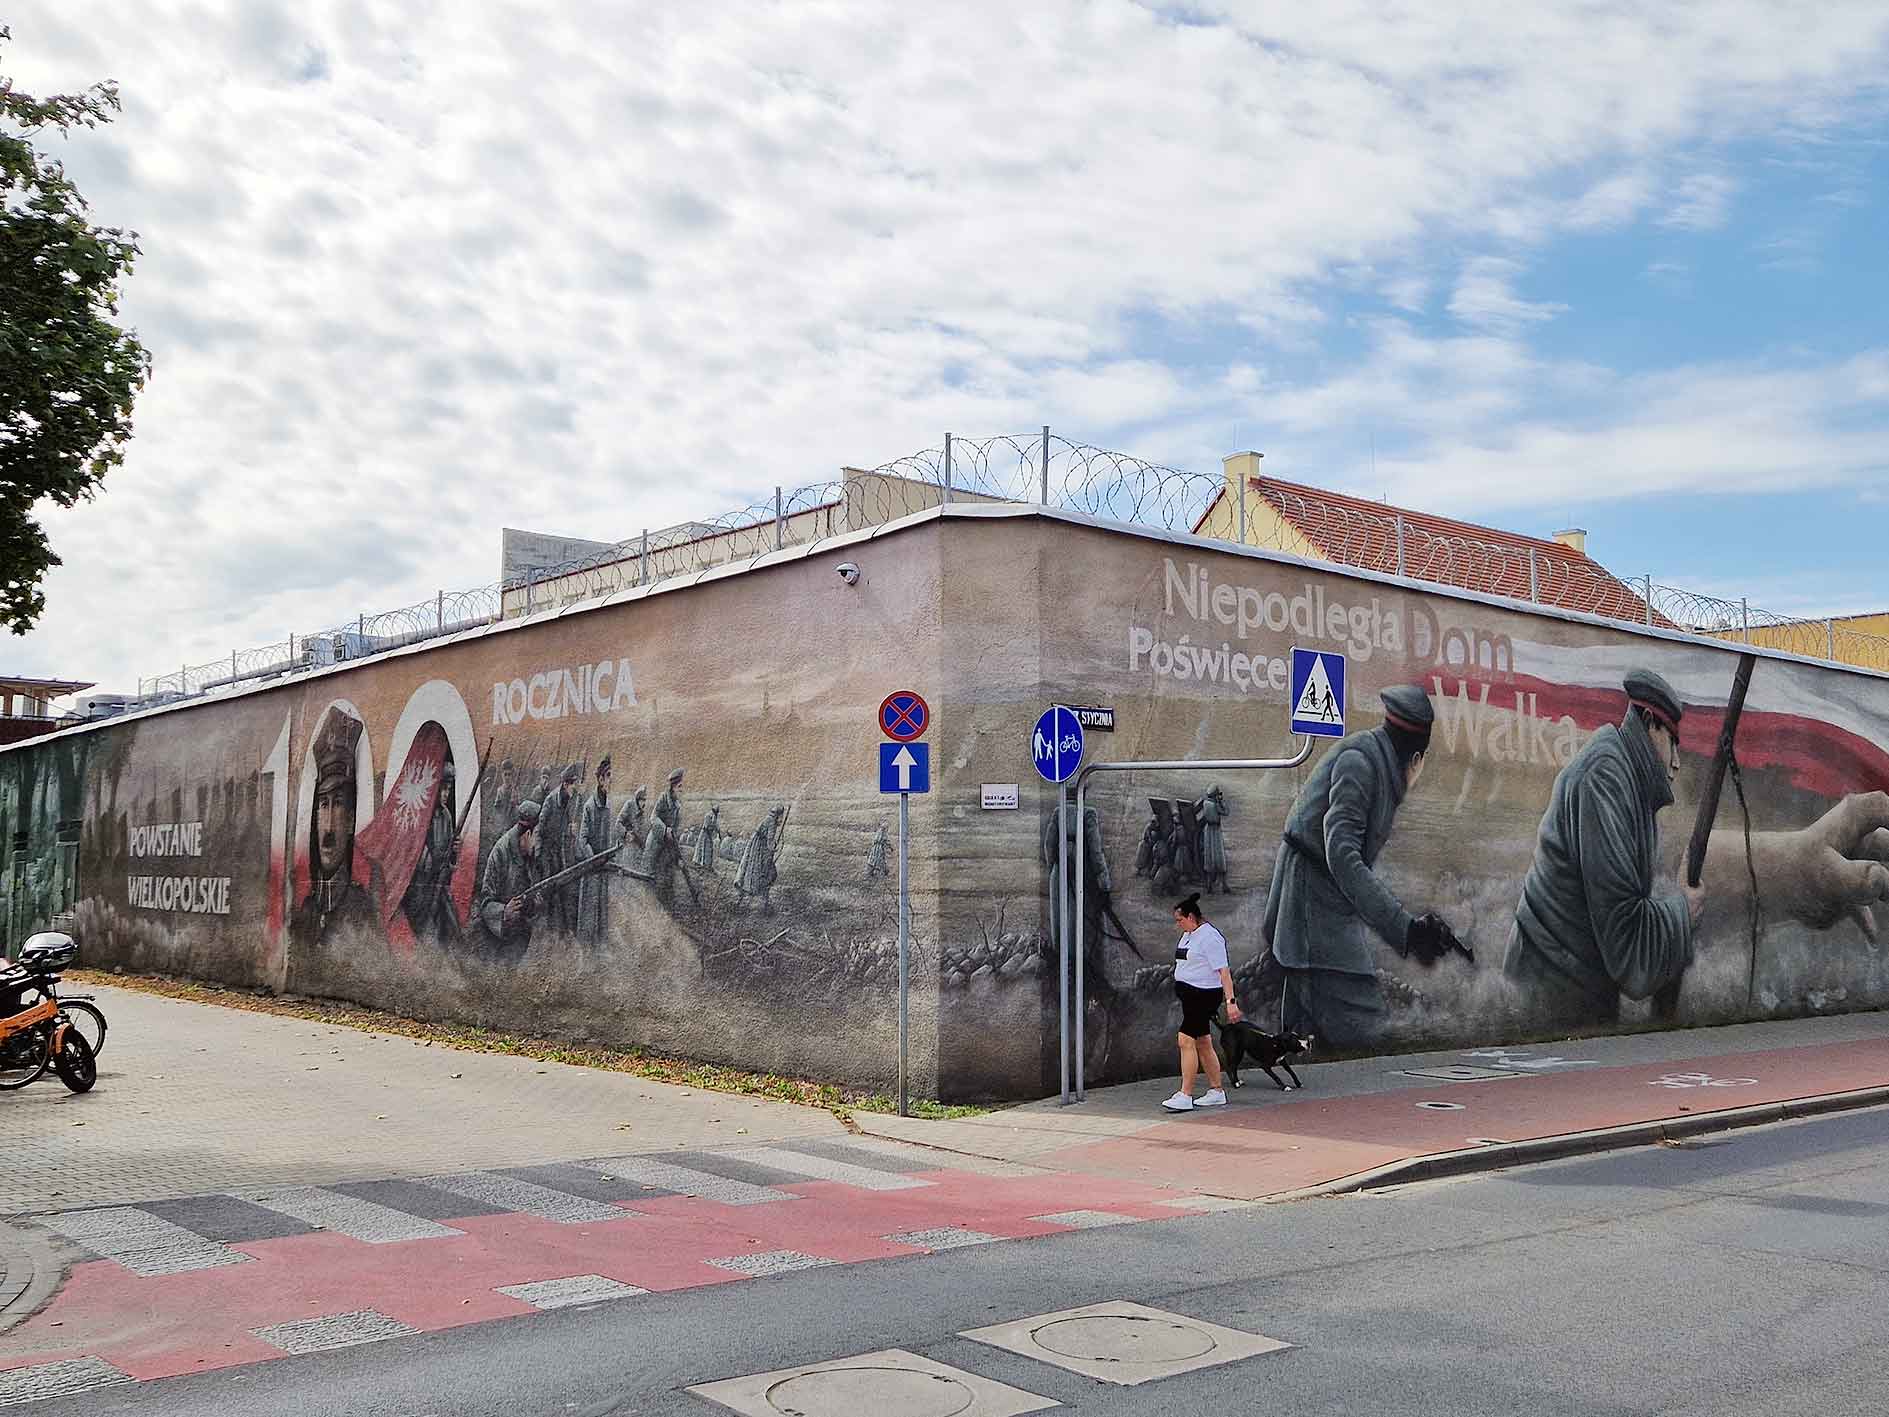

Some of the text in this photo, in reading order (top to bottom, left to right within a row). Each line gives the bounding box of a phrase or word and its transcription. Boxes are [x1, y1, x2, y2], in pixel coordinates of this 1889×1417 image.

[1163, 558, 1514, 686] Niepodległa Dom
[493, 657, 637, 725] ROCZNICA
[1128, 626, 1290, 693] Poświęce
[1081, 711, 1113, 726] STYCZNIA
[1432, 676, 1578, 768] Walka
[129, 822, 202, 857] POWSTANIE
[253, 679, 481, 960] 100
[128, 876, 231, 914] WIELKOPOLSKIE
